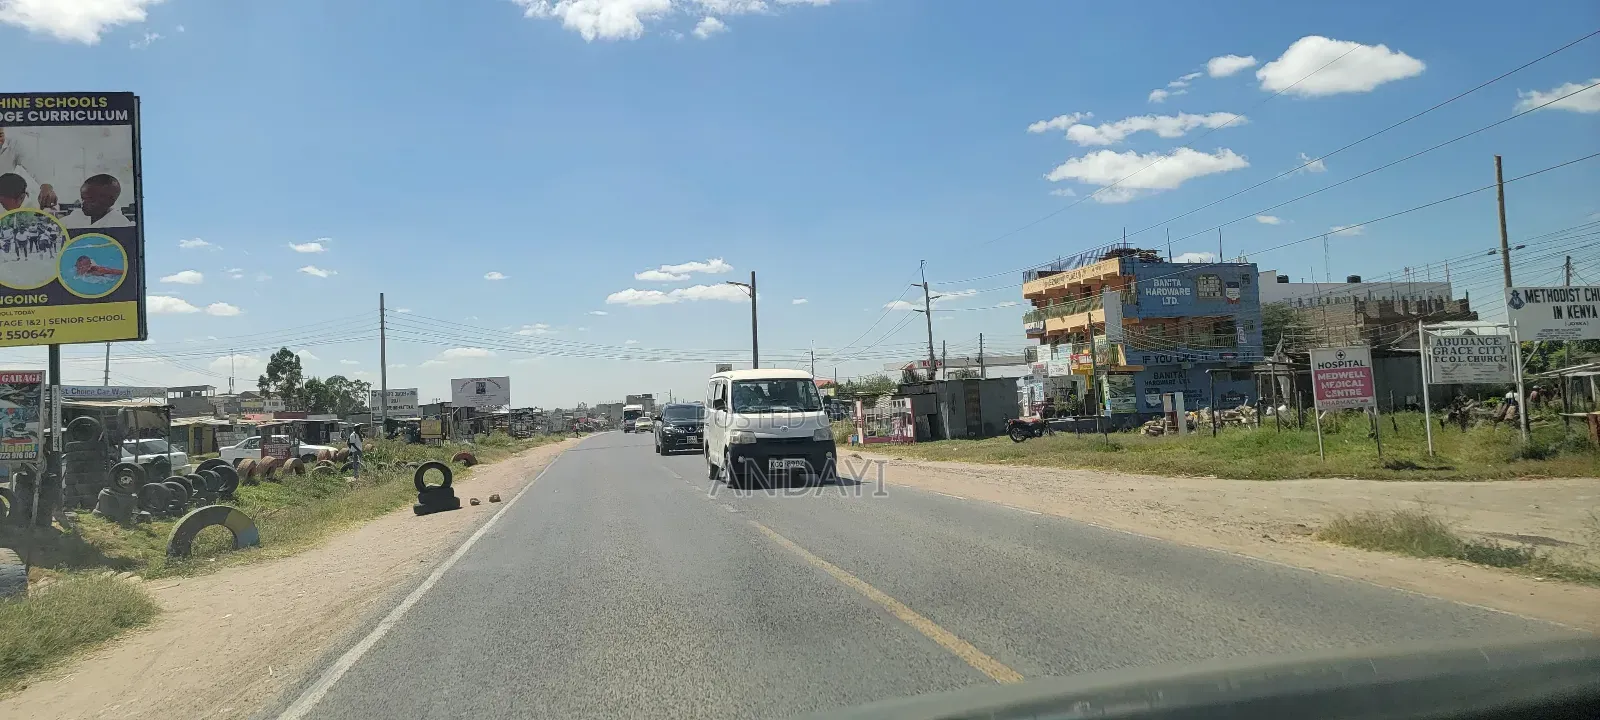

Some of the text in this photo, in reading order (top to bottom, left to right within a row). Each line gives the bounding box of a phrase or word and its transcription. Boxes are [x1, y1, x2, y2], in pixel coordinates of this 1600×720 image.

[35, 96, 108, 108] SCHOOLS
[27, 109, 128, 121] CURRICULUM
[1153, 278, 1181, 287] BANITA
[1145, 287, 1191, 296] HARDWARE
[1524, 288, 1580, 304] METHODIST
[1162, 296, 1180, 305] LTD.
[1553, 304, 1598, 320] IN KENYA
[26, 318, 41, 326] 1&2
[48, 316, 84, 325] SENIOR
[86, 314, 126, 323] SCHOOL
[6, 328, 56, 341] 550647
[1436, 337, 1502, 347] ABUDANCE
[1433, 345, 1506, 356] GRACE CITY
[1142, 355, 1151, 364] IF
[1154, 354, 1172, 363] YOU
[1467, 355, 1508, 363] CHURCH
[1318, 360, 1366, 369] HOSPITAL
[1, 374, 42, 383] GARAGE
[1317, 370, 1366, 380] MEDWELL
[1321, 380, 1364, 389] MEDICAL
[71, 387, 94, 396] Choice
[96, 388, 110, 396] Car
[112, 388, 131, 397] Wash
[1325, 389, 1362, 398] CENTRE
[1321, 399, 1359, 407] PHARMACY
